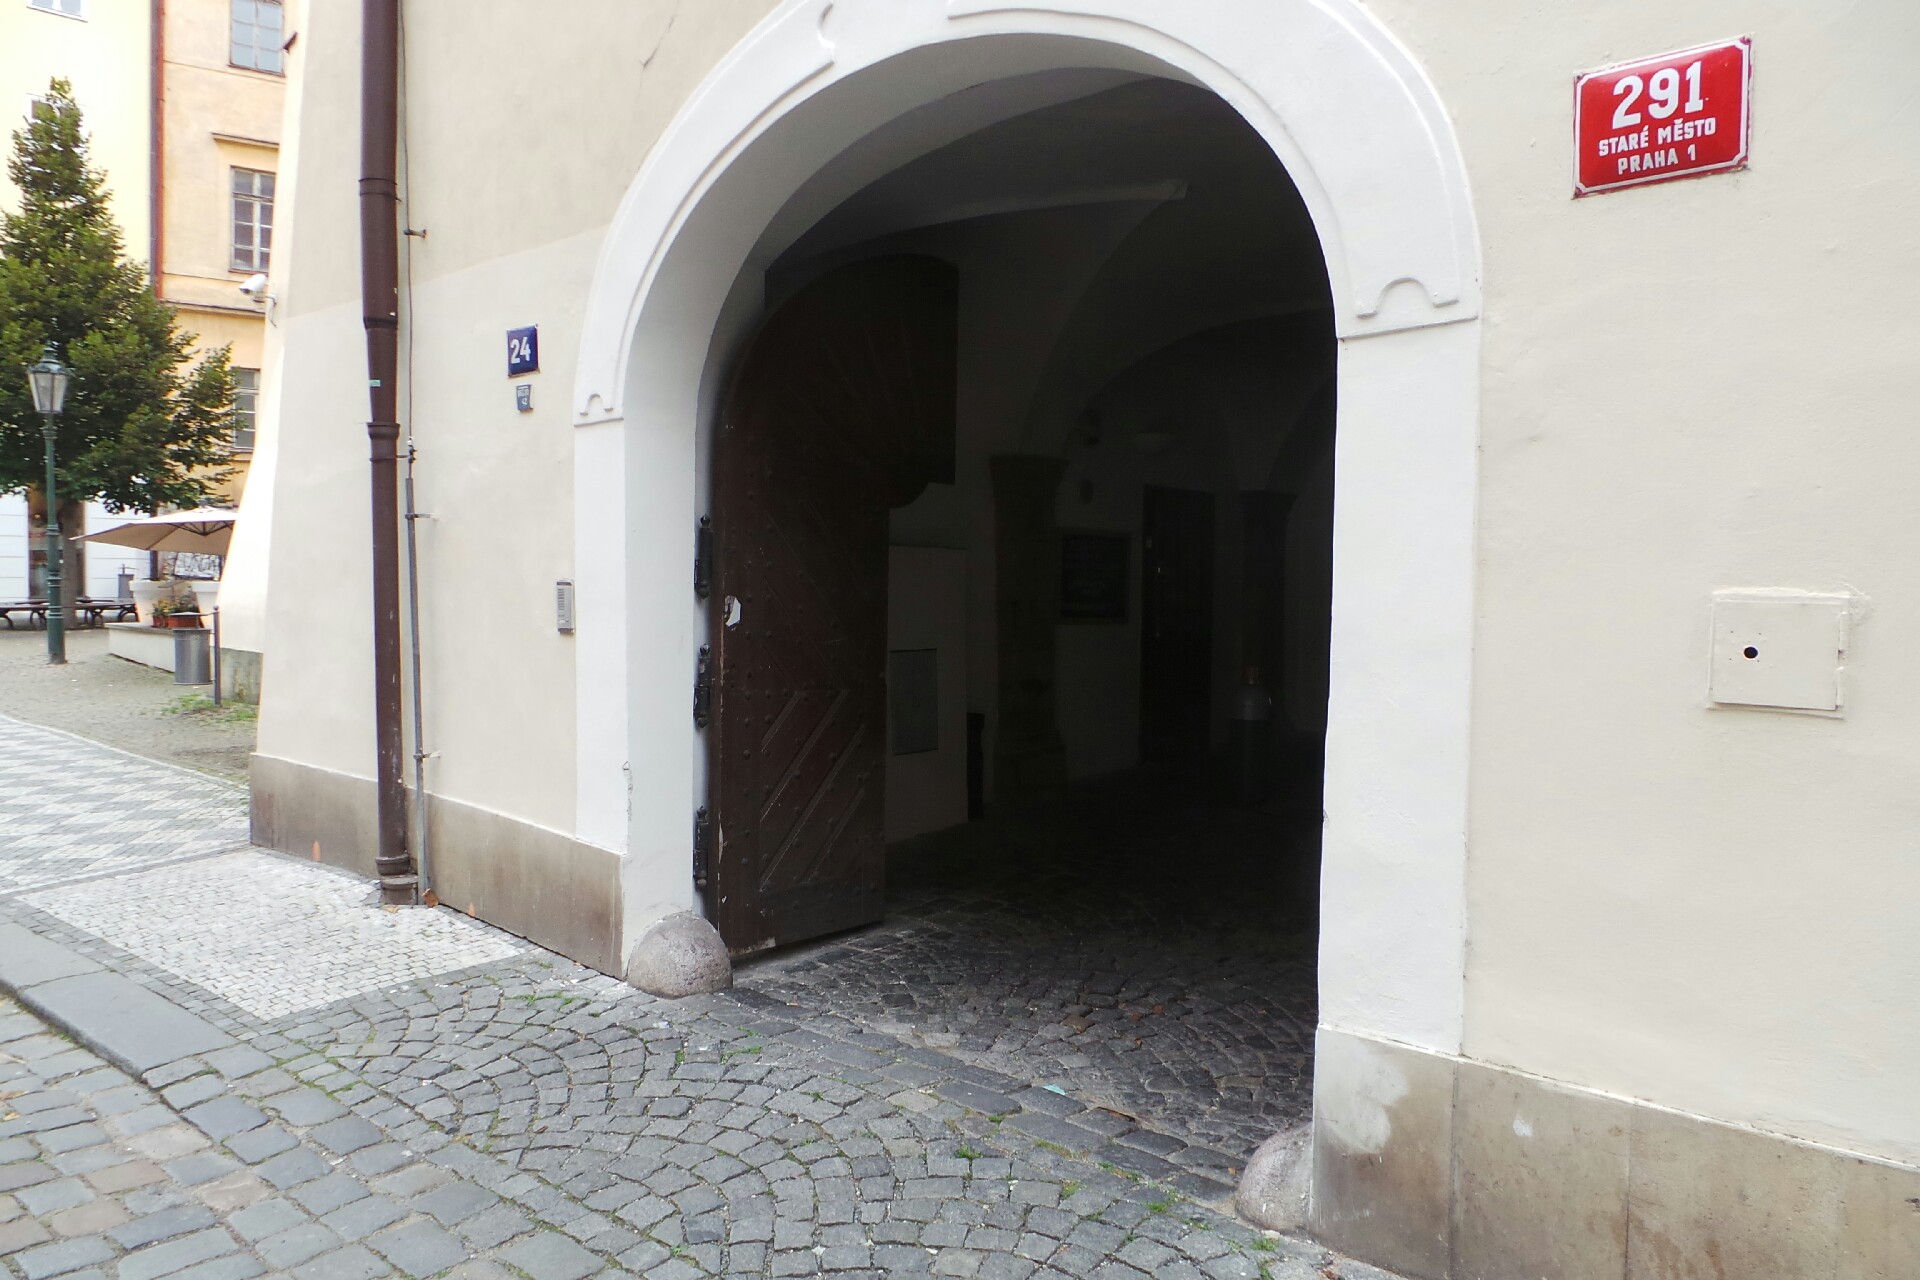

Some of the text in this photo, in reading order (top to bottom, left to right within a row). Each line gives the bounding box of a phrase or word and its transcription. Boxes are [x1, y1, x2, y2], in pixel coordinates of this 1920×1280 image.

[1612, 60, 1703, 129] 291
[1598, 118, 1716, 157] STARÉ MĚSTO
[1617, 144, 1696, 175] PRAHA 1
[510, 336, 531, 364] 24
